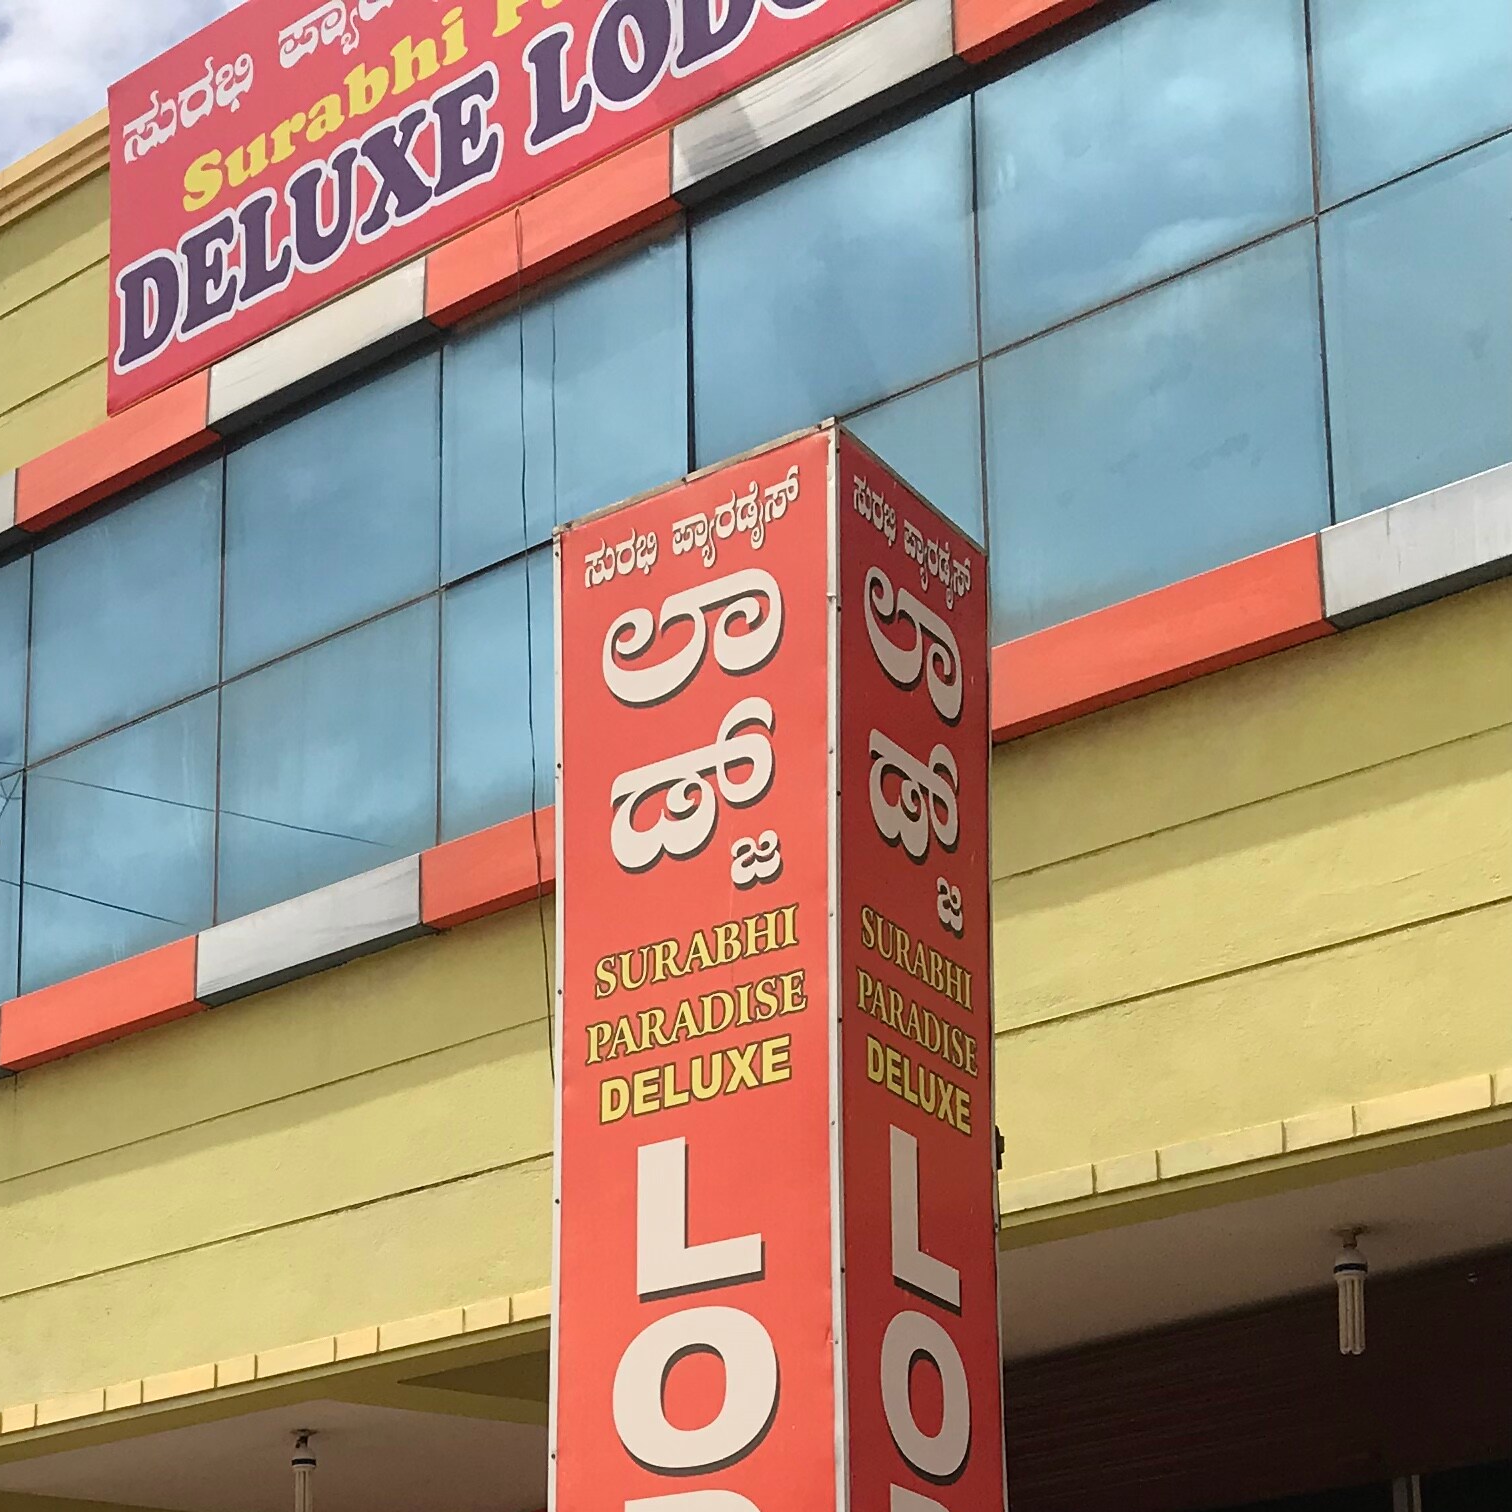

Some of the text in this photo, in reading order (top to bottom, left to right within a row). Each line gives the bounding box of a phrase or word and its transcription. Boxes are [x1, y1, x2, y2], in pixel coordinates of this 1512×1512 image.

[121, 53, 256, 163] ಸುರಭಿ
[181, 7, 468, 212] Surabhi
[115, 0, 818, 374] DELUXE LOD
[584, 527, 658, 588] ಸುರಭಿ
[853, 474, 897, 547] ಸುರಭಿ
[594, 904, 799, 999] SURABHI
[860, 905, 974, 1012] SURABHI
[585, 970, 807, 1065] PARADISE
[856, 968, 978, 1078] PARADISE
[599, 1035, 792, 1125] DELUXE
[865, 1035, 972, 1136] DELUXE
